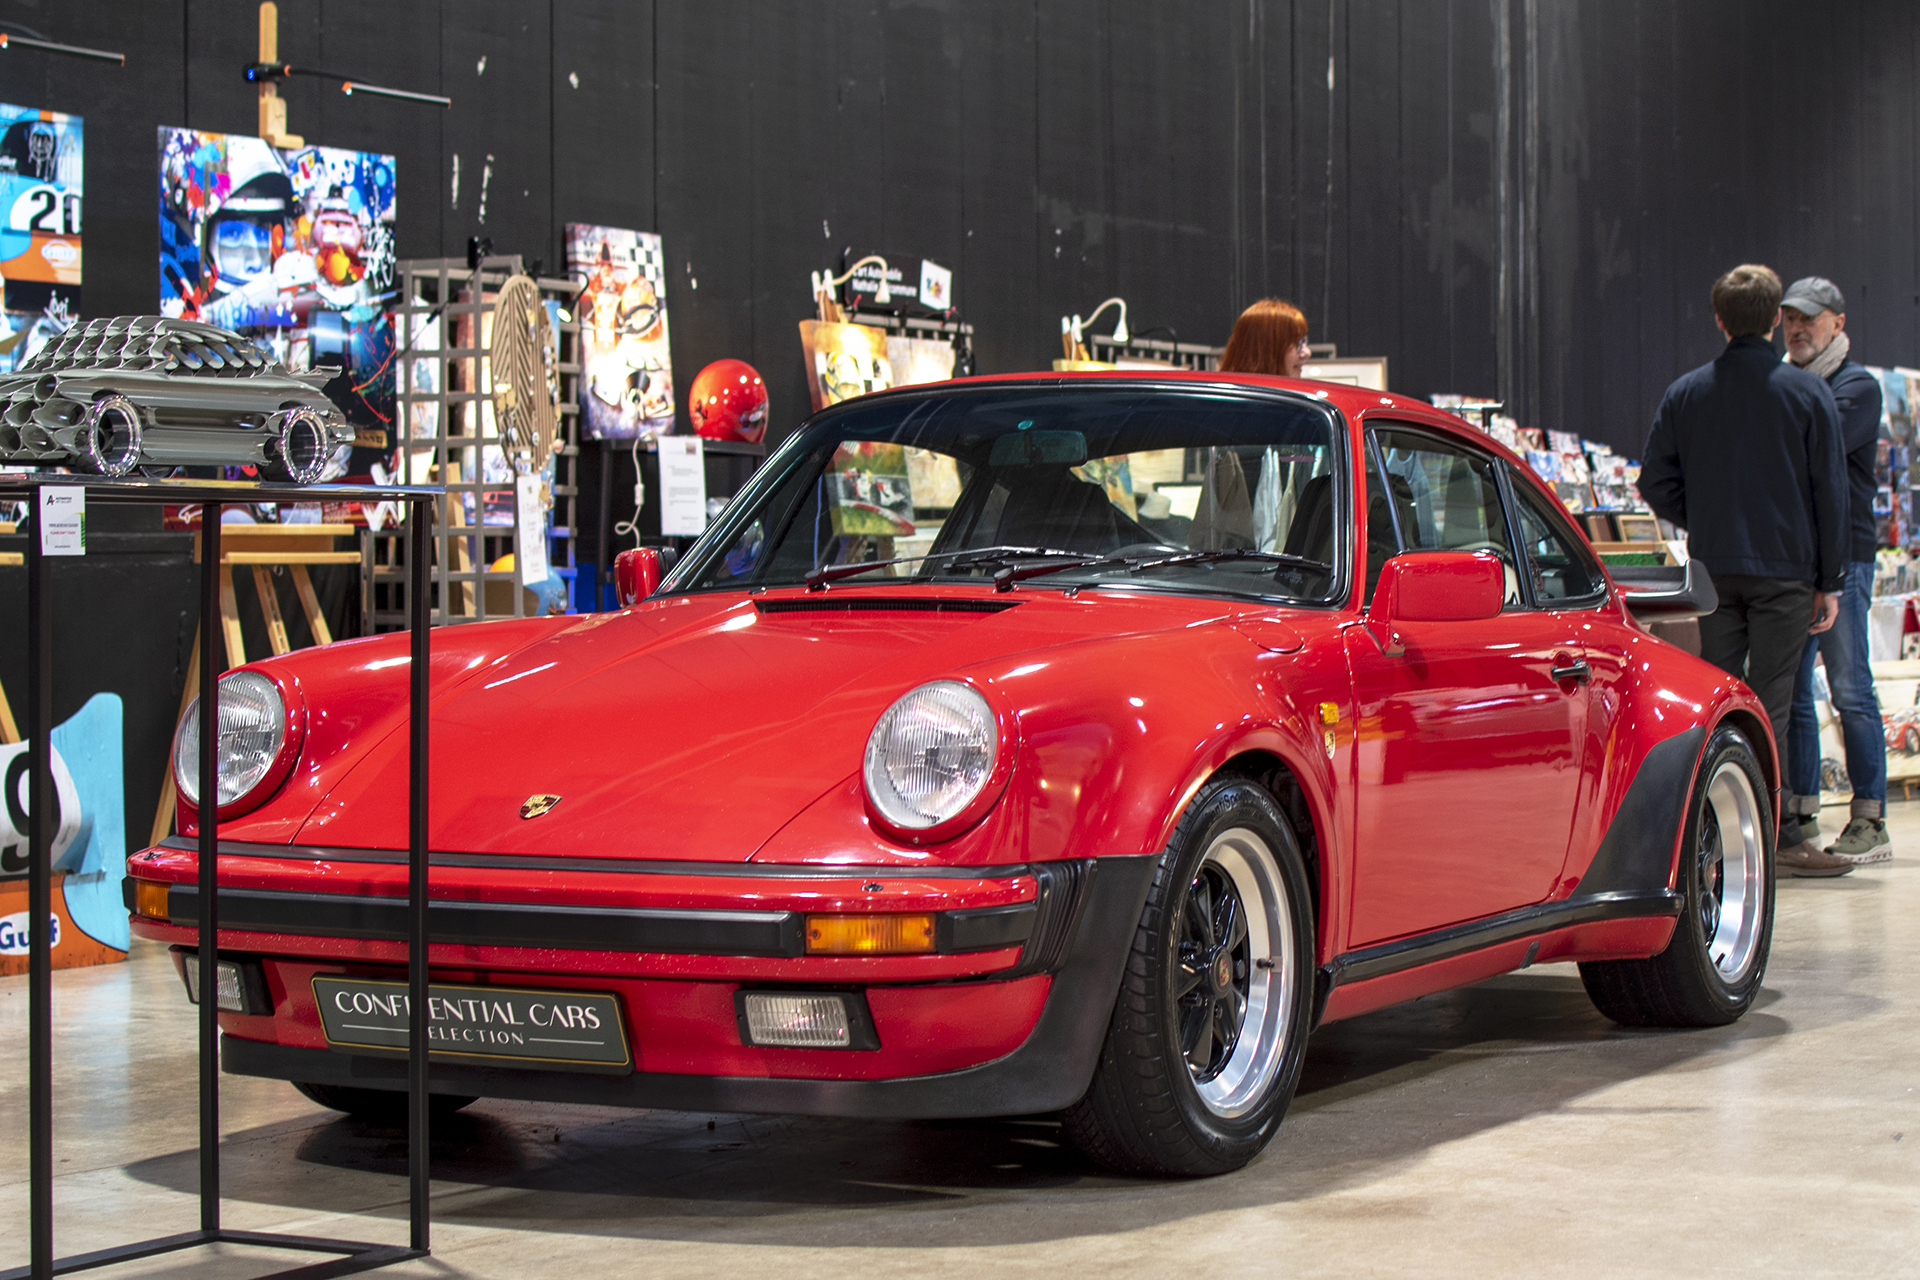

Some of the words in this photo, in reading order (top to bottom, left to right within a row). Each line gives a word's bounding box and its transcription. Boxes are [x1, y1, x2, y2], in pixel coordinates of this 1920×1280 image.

[0, 918, 58, 950] Guf
[335, 991, 524, 1025] CONFIENTIAL
[529, 1003, 601, 1030] CARS
[427, 1025, 524, 1046] ELECTION
